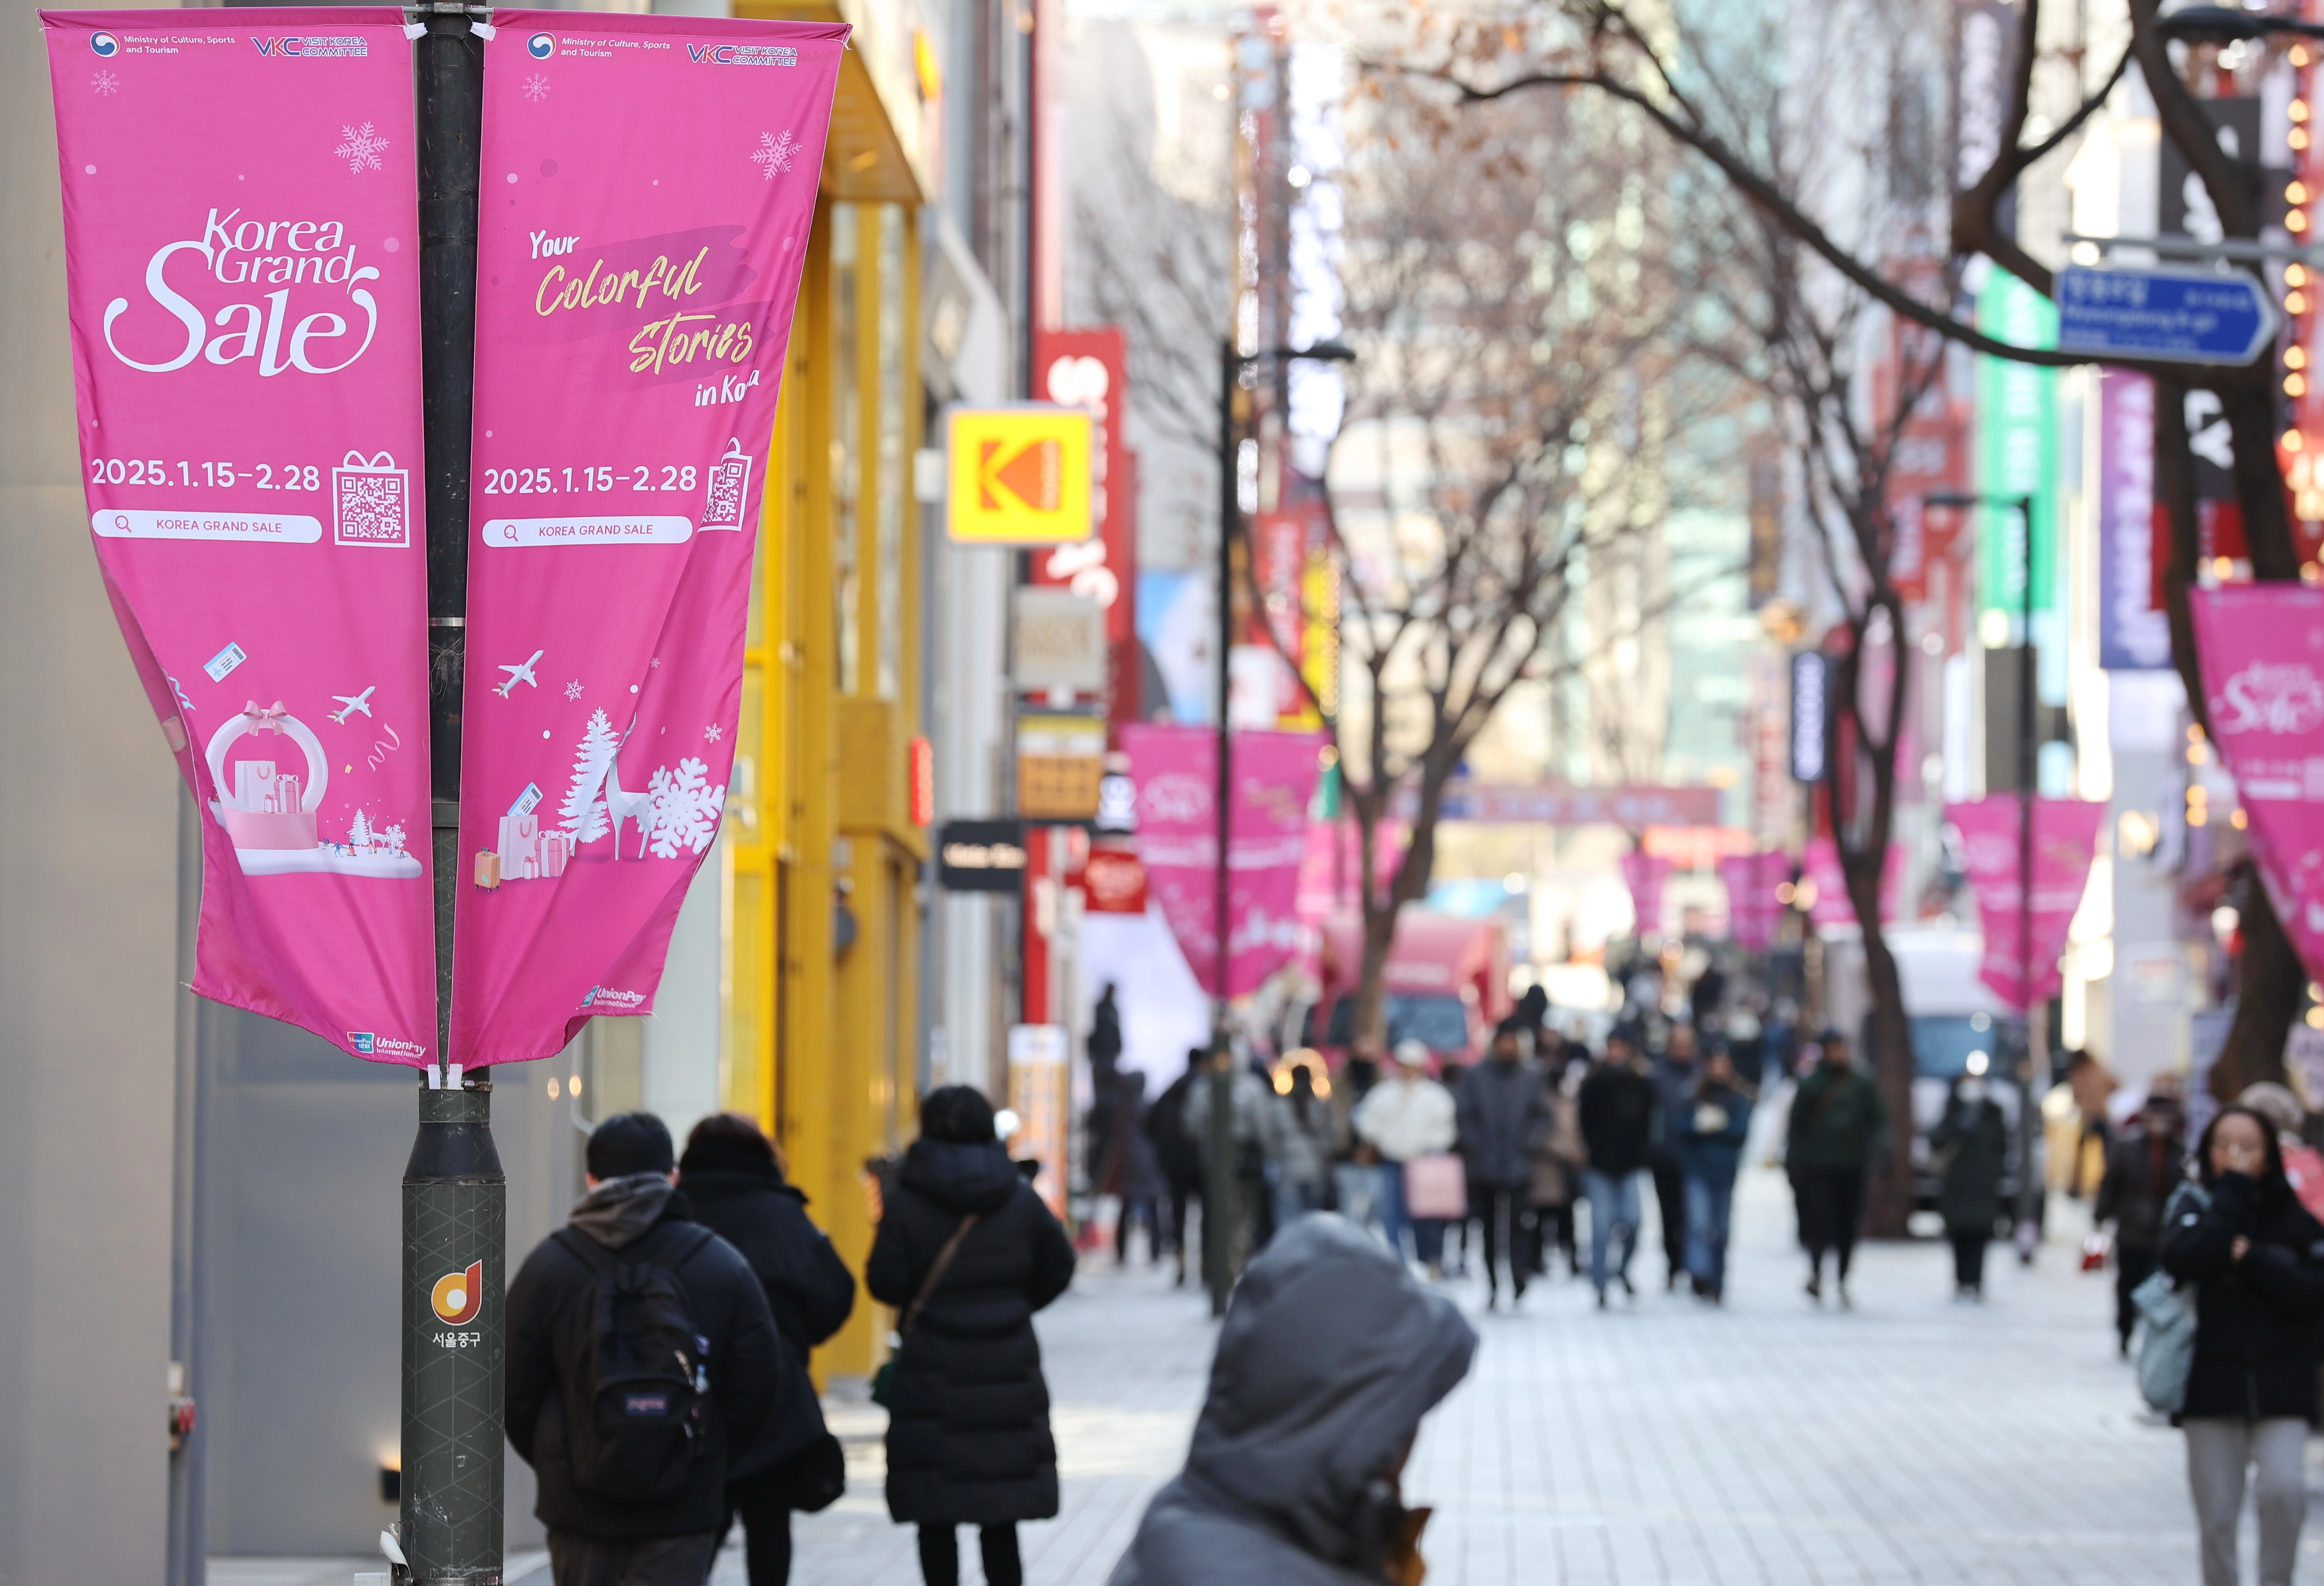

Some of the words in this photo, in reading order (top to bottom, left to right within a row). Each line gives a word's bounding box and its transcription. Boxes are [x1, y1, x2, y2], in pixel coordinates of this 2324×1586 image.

[124, 36, 158, 44] Ministry
[171, 36, 205, 44] Culture,
[206, 36, 236, 44] Sports
[250, 37, 301, 56] VKC
[300, 37, 328, 45] VISIT
[329, 37, 367, 45] KOREA
[562, 37, 595, 47] Ministry
[608, 40, 641, 48] Culture,
[642, 41, 670, 50] Sports
[302, 47, 368, 56] COMMITTEE
[580, 49, 612, 57] Tourism
[686, 43, 733, 64] VKC
[734, 46, 761, 55] VISIT
[762, 46, 798, 56] KOREA
[732, 55, 797, 66] COMMITTEE
[202, 208, 344, 252] Korea
[529, 229, 581, 259] Your
[215, 245, 356, 283] Grand
[535, 245, 709, 316] Colorful
[103, 240, 378, 377] Sale
[695, 384, 716, 407] in
[156, 519, 199, 530] KOREA
[203, 521, 249, 532] GRAND
[252, 522, 282, 533] SALE
[539, 525, 576, 536] KOREA
[579, 525, 621, 536] GRAND
[624, 524, 653, 535] SALE
[597, 987, 647, 1005] UnionPay
[376, 1037, 426, 1057] UnionPay
[432, 1332, 481, 1348] 서울중구
